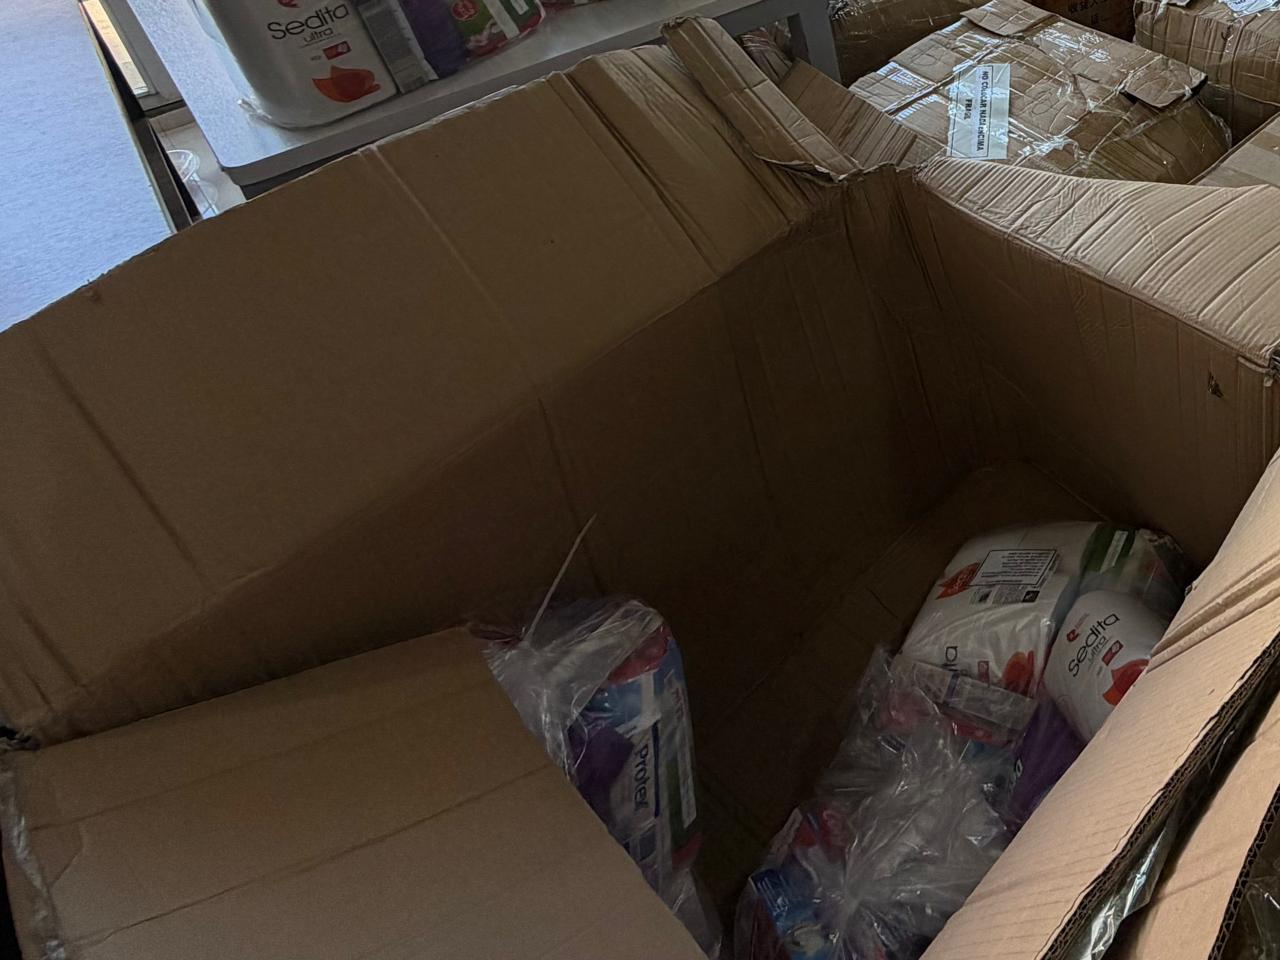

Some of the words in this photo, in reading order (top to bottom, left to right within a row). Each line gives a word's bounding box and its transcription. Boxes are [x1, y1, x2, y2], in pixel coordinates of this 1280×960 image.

[267, 3, 350, 40] Sedita
[303, 28, 334, 43] ultra
[981, 71, 989, 80] NO
[1067, 613, 1121, 678] Sedita
